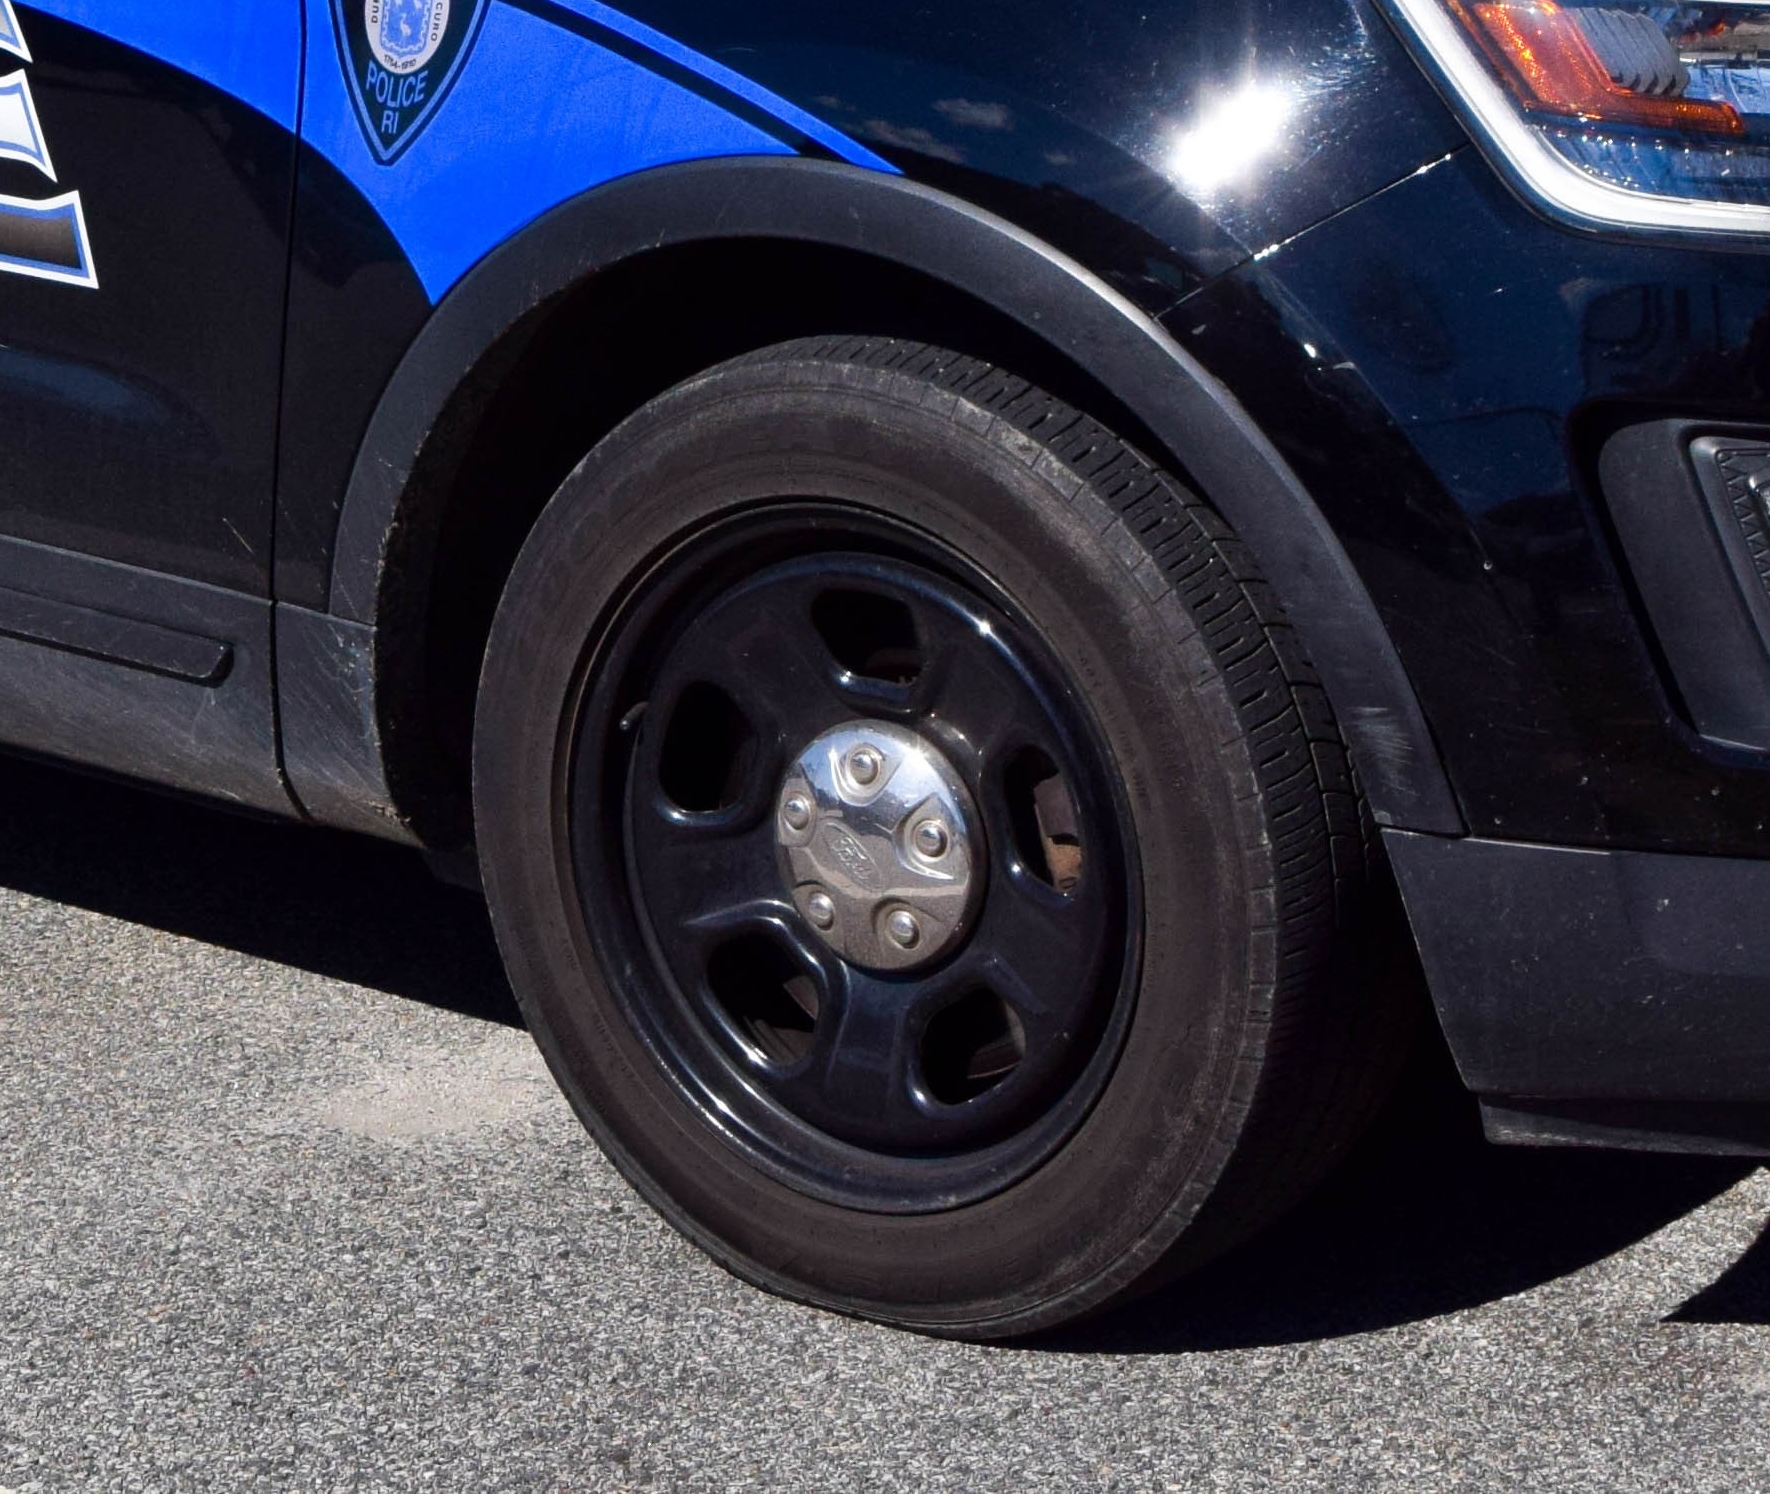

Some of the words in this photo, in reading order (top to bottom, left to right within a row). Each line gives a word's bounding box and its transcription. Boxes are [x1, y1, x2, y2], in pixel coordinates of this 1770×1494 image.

[431, 2, 444, 42] CURO
[366, 60, 428, 107] POLICE
[382, 111, 398, 133] RI
